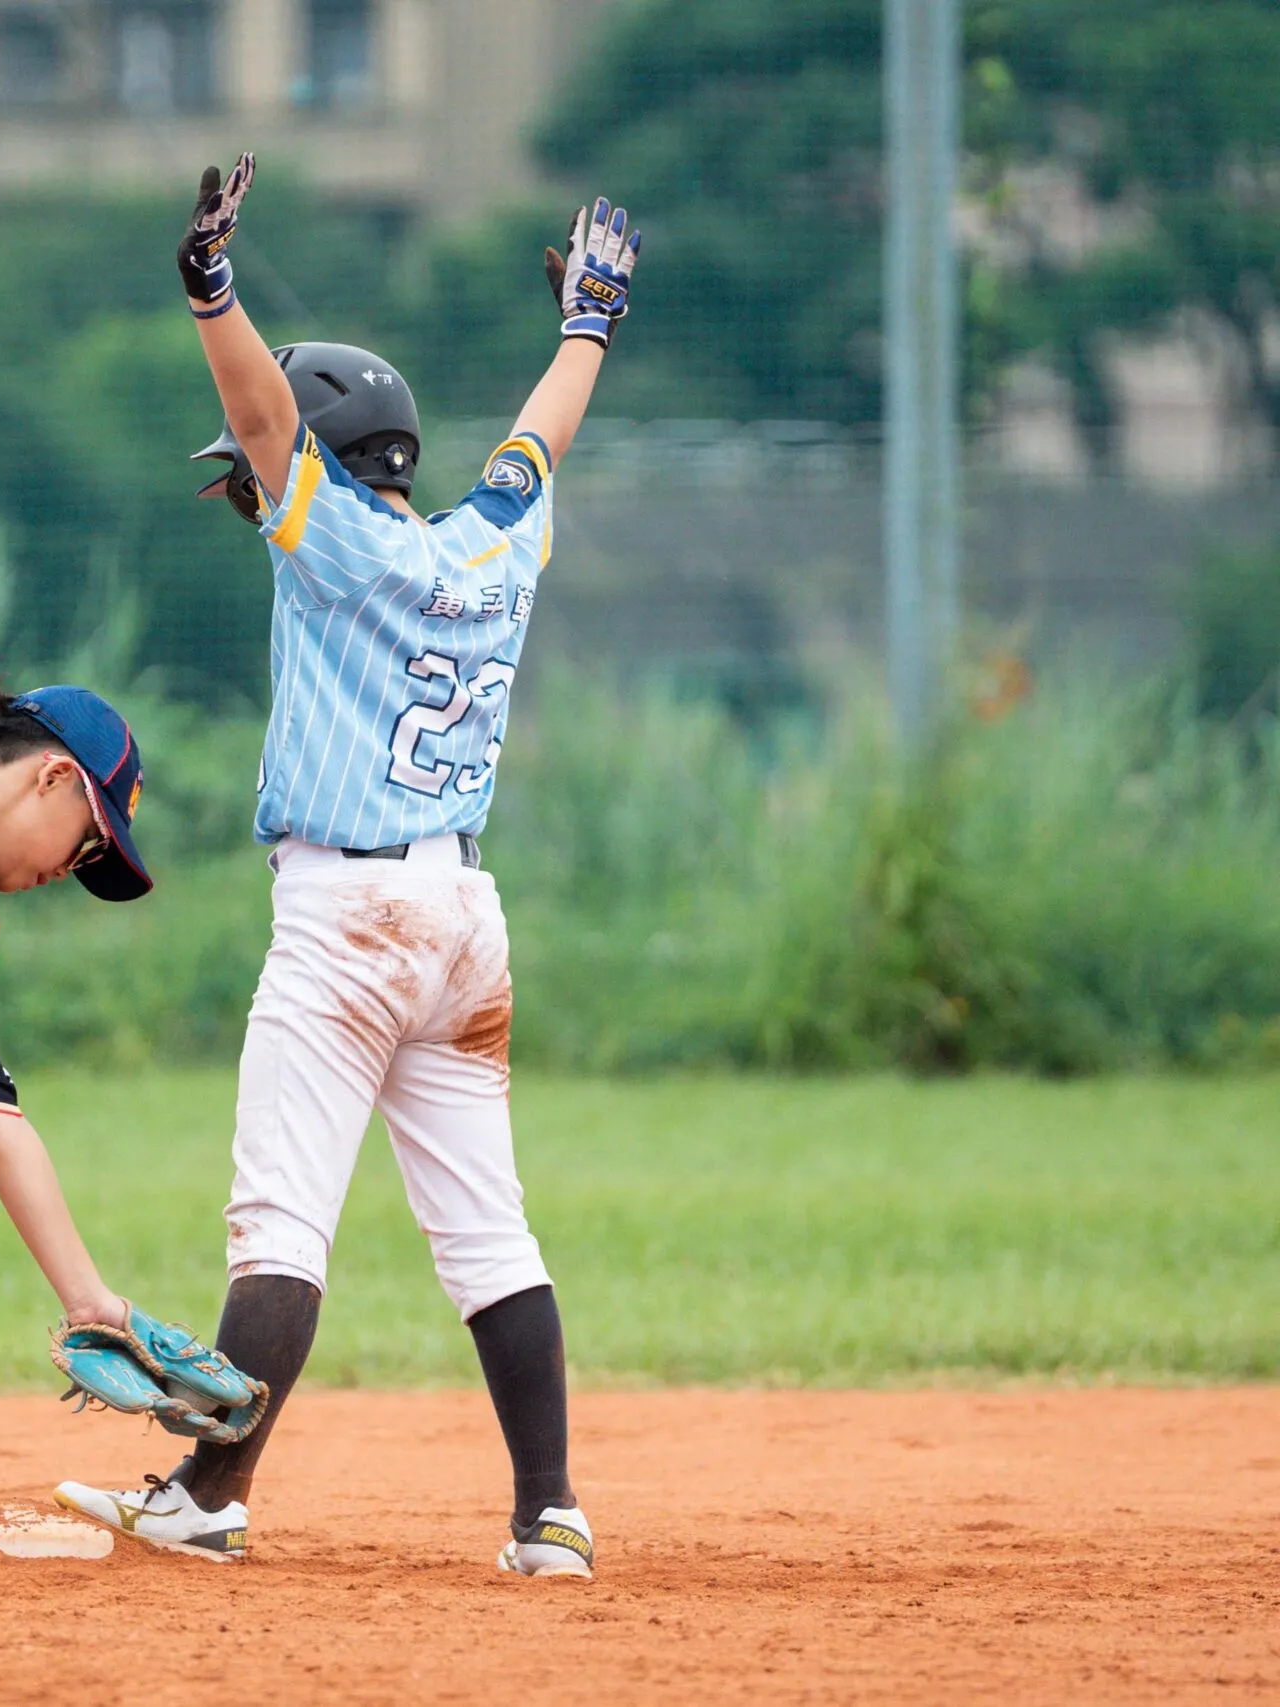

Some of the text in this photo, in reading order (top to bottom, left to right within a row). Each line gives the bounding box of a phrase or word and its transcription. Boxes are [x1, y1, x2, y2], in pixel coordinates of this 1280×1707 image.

[581, 275, 619, 301] ZETT
[385, 649, 517, 800] 23
[540, 1525, 591, 1556] MIZUNO
